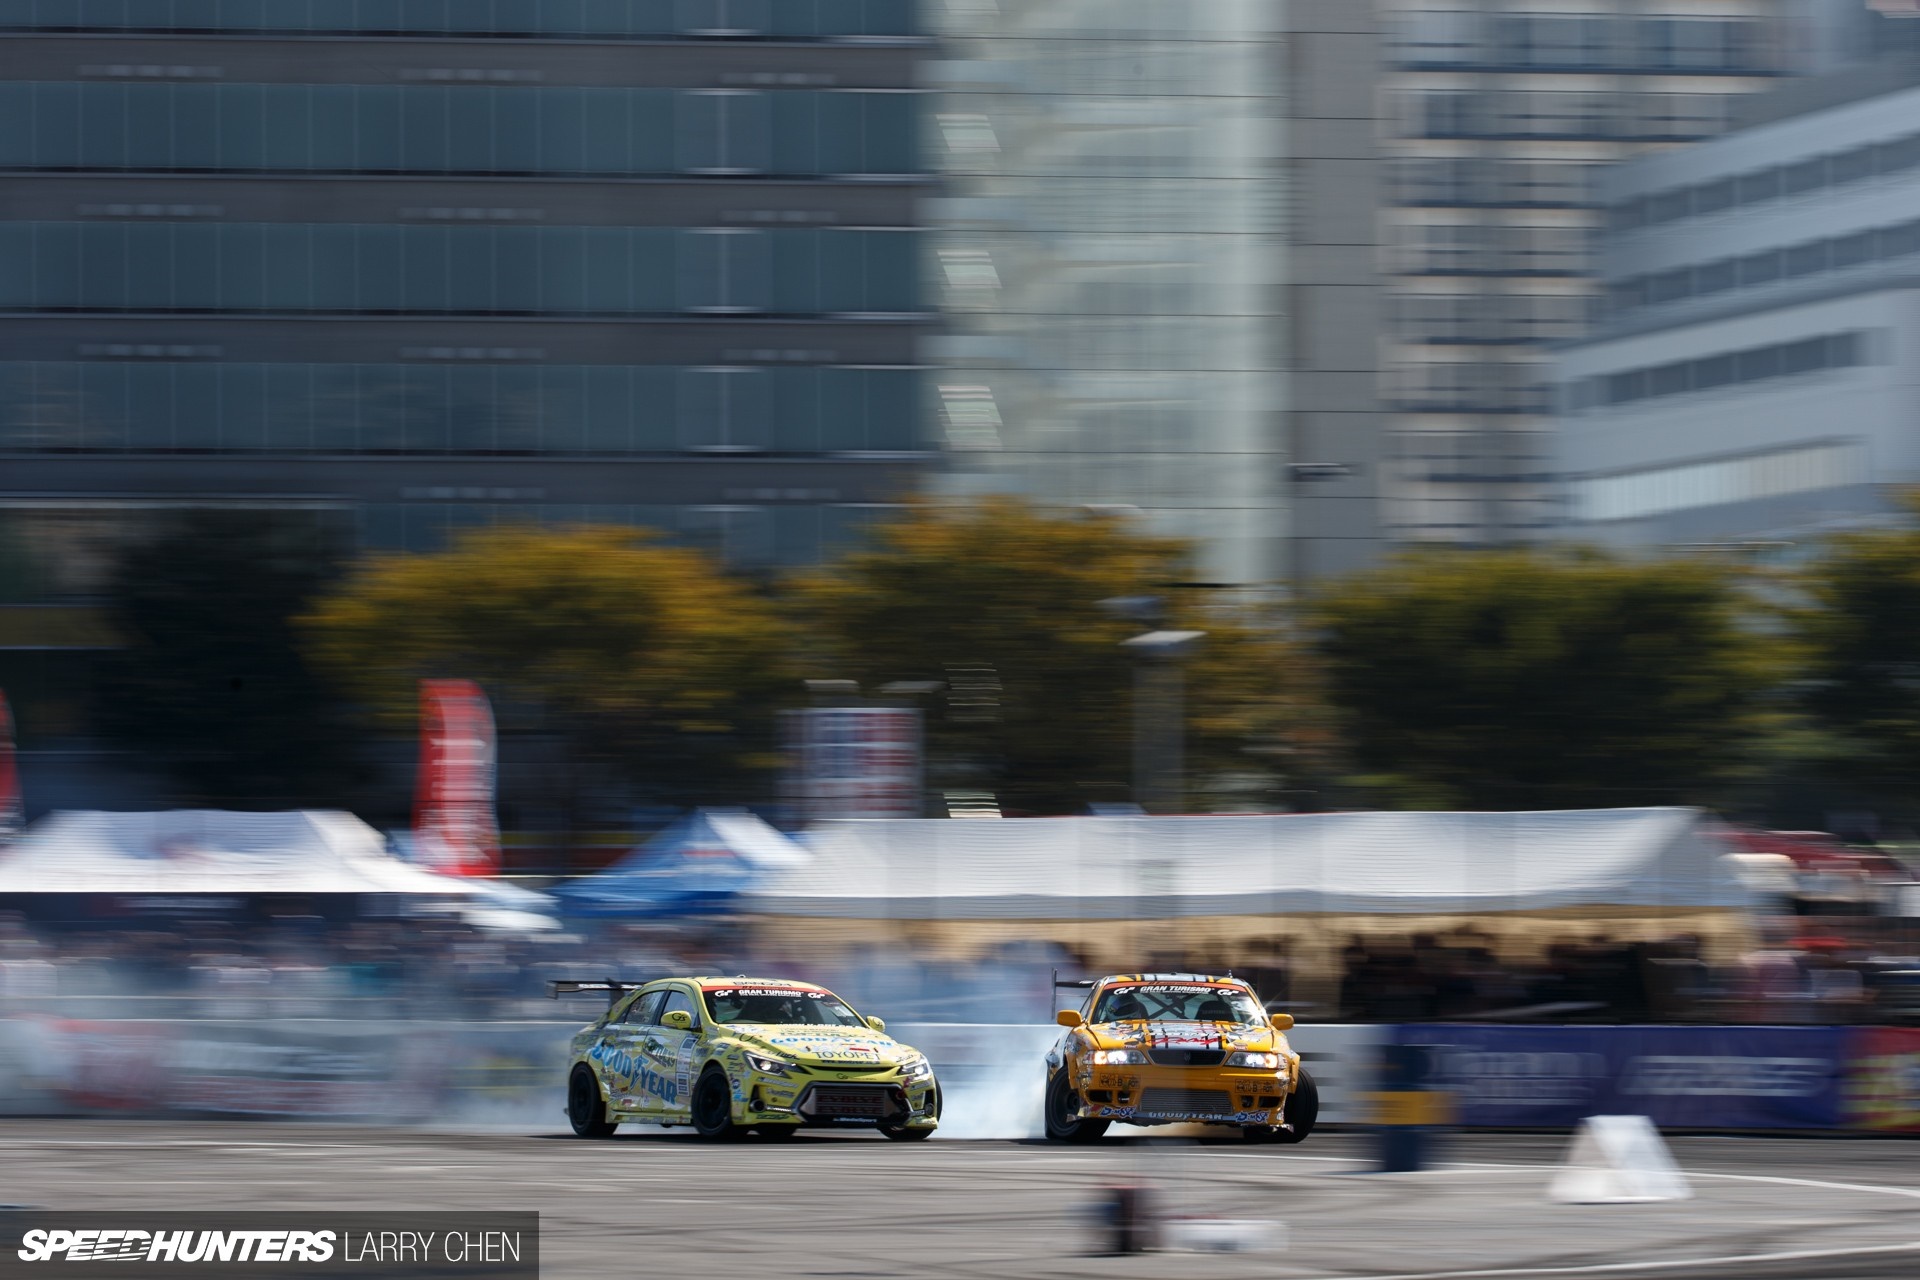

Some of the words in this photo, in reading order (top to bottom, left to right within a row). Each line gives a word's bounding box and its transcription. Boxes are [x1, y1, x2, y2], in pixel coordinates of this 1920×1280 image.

[764, 989, 802, 997] TURISMO
[1169, 986, 1212, 994] TURISMO
[811, 1051, 881, 1060] TOYOPET
